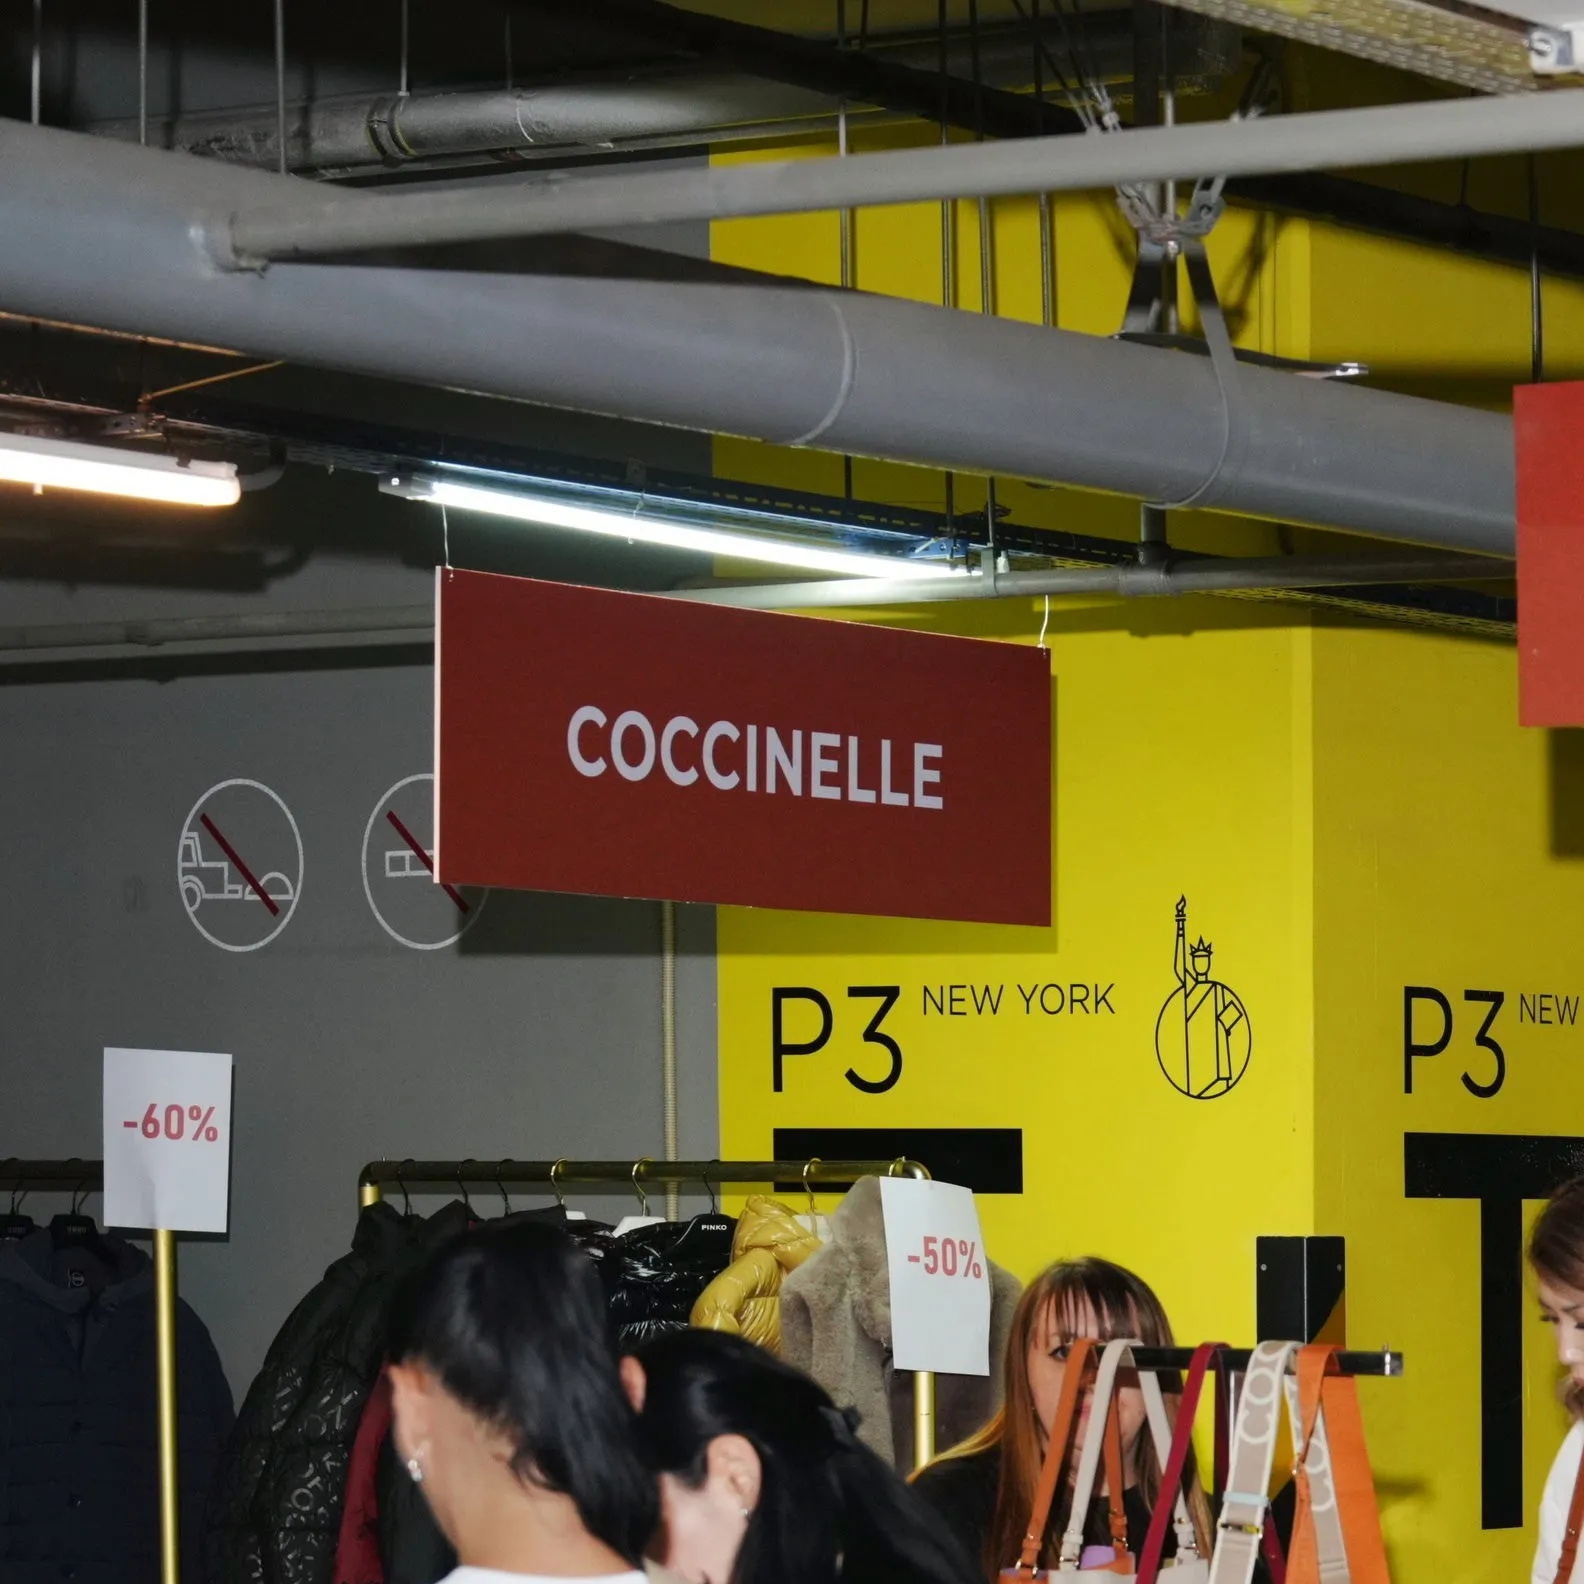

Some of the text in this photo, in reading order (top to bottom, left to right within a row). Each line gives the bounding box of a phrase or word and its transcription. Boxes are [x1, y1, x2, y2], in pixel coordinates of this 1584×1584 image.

[566, 705, 945, 811] COCCINELLE
[772, 983, 1115, 1095] P3 NEW YORK
[1403, 985, 1506, 1099] P3
[1519, 993, 1580, 1027] NEW
[123, 1104, 218, 1143] -60%
[907, 1236, 982, 1281] -50%
